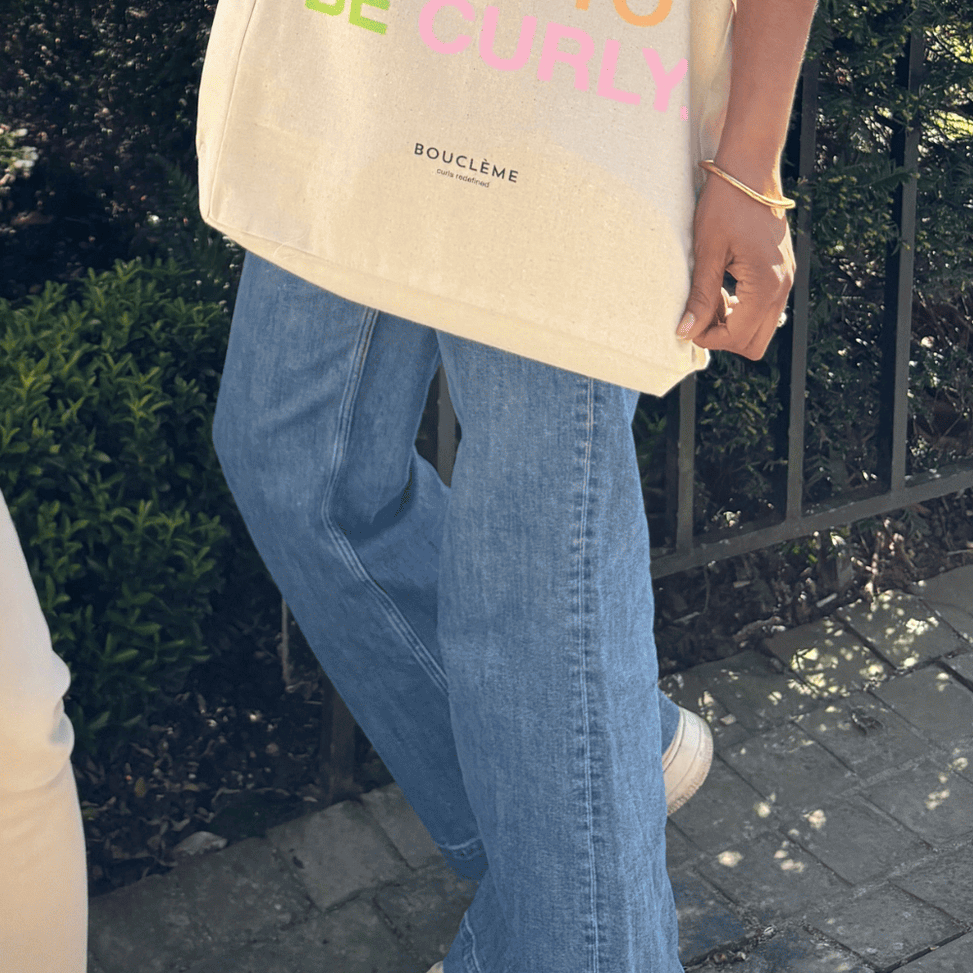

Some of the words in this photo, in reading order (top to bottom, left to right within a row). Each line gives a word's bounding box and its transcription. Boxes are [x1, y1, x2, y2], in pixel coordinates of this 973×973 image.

[414, 142, 519, 183] BOUCLÈME
[436, 168, 454, 178] curls
[455, 173, 490, 188] redefined
